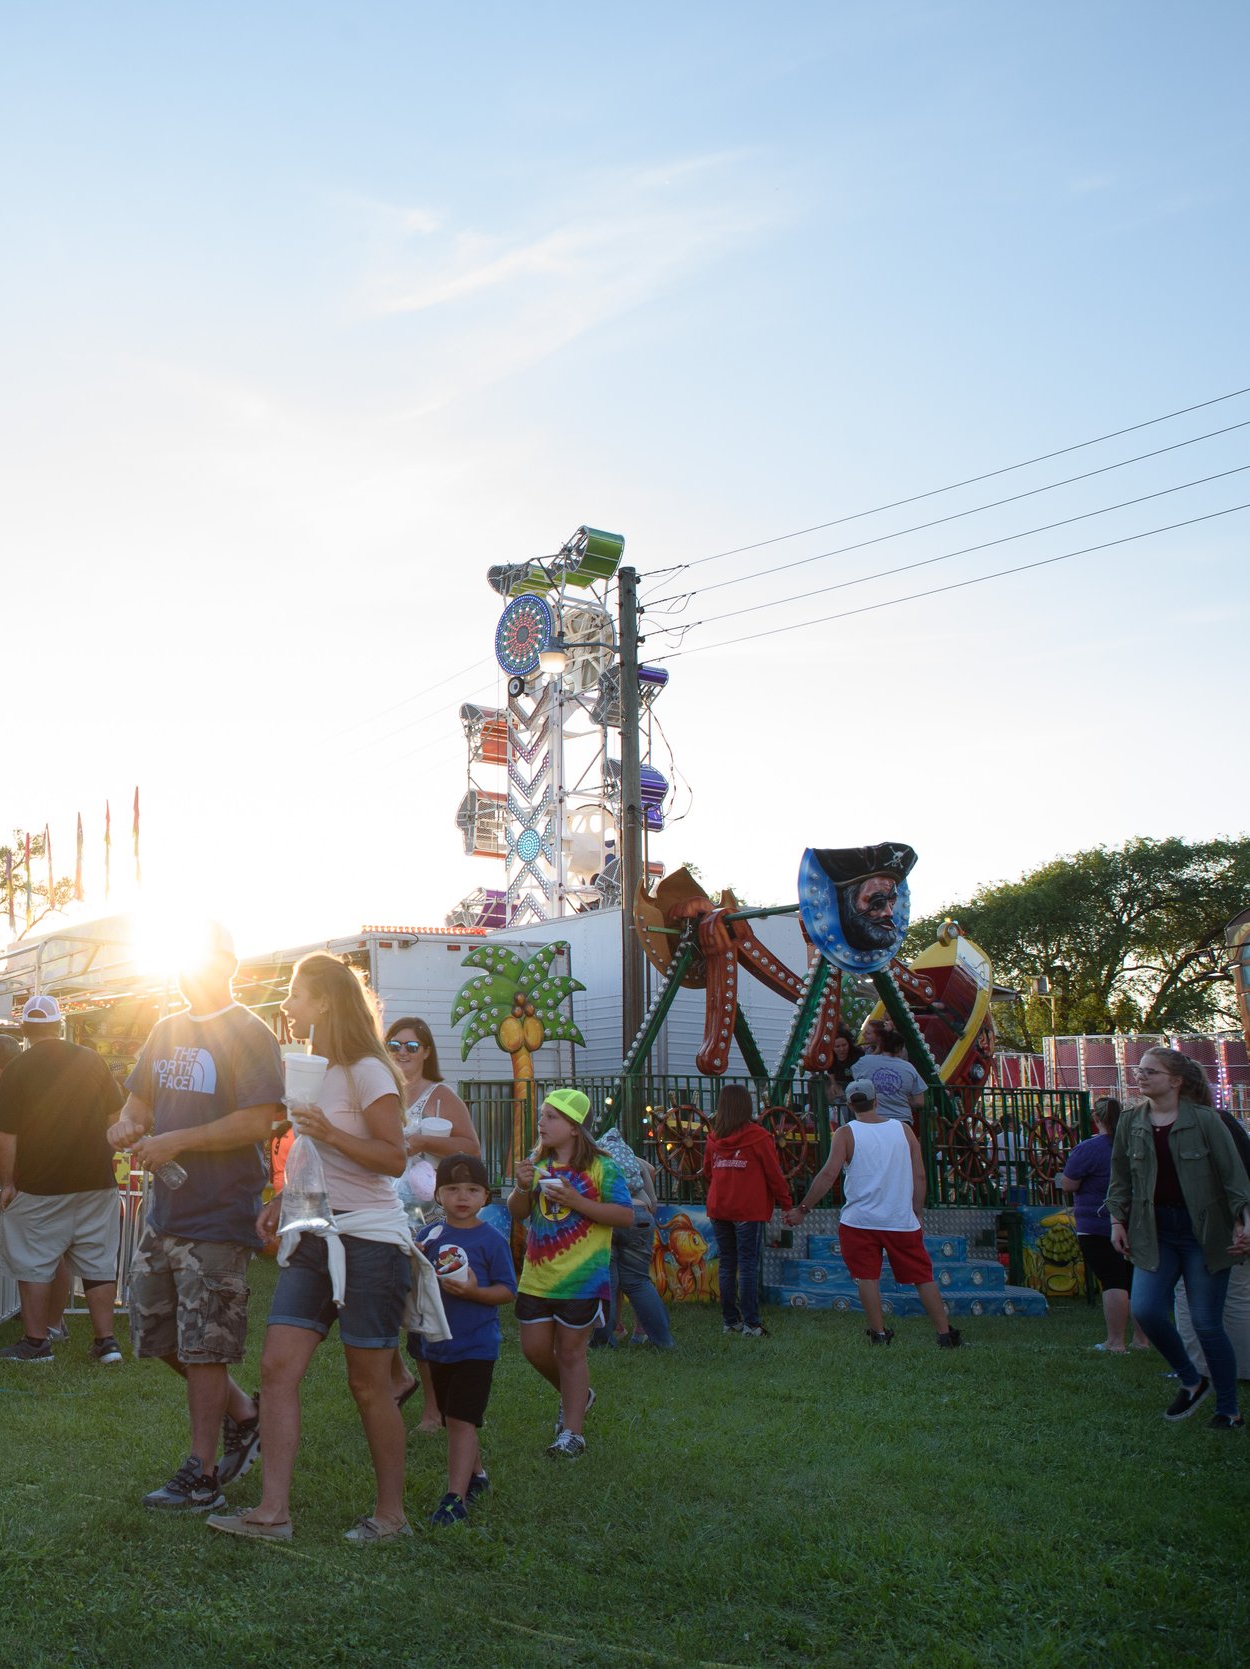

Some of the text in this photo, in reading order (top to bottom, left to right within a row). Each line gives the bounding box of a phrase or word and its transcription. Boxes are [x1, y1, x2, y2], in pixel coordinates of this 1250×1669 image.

[174, 1046, 199, 1061] THE
[153, 1060, 193, 1076] NORTH
[159, 1074, 190, 1091] FACE
